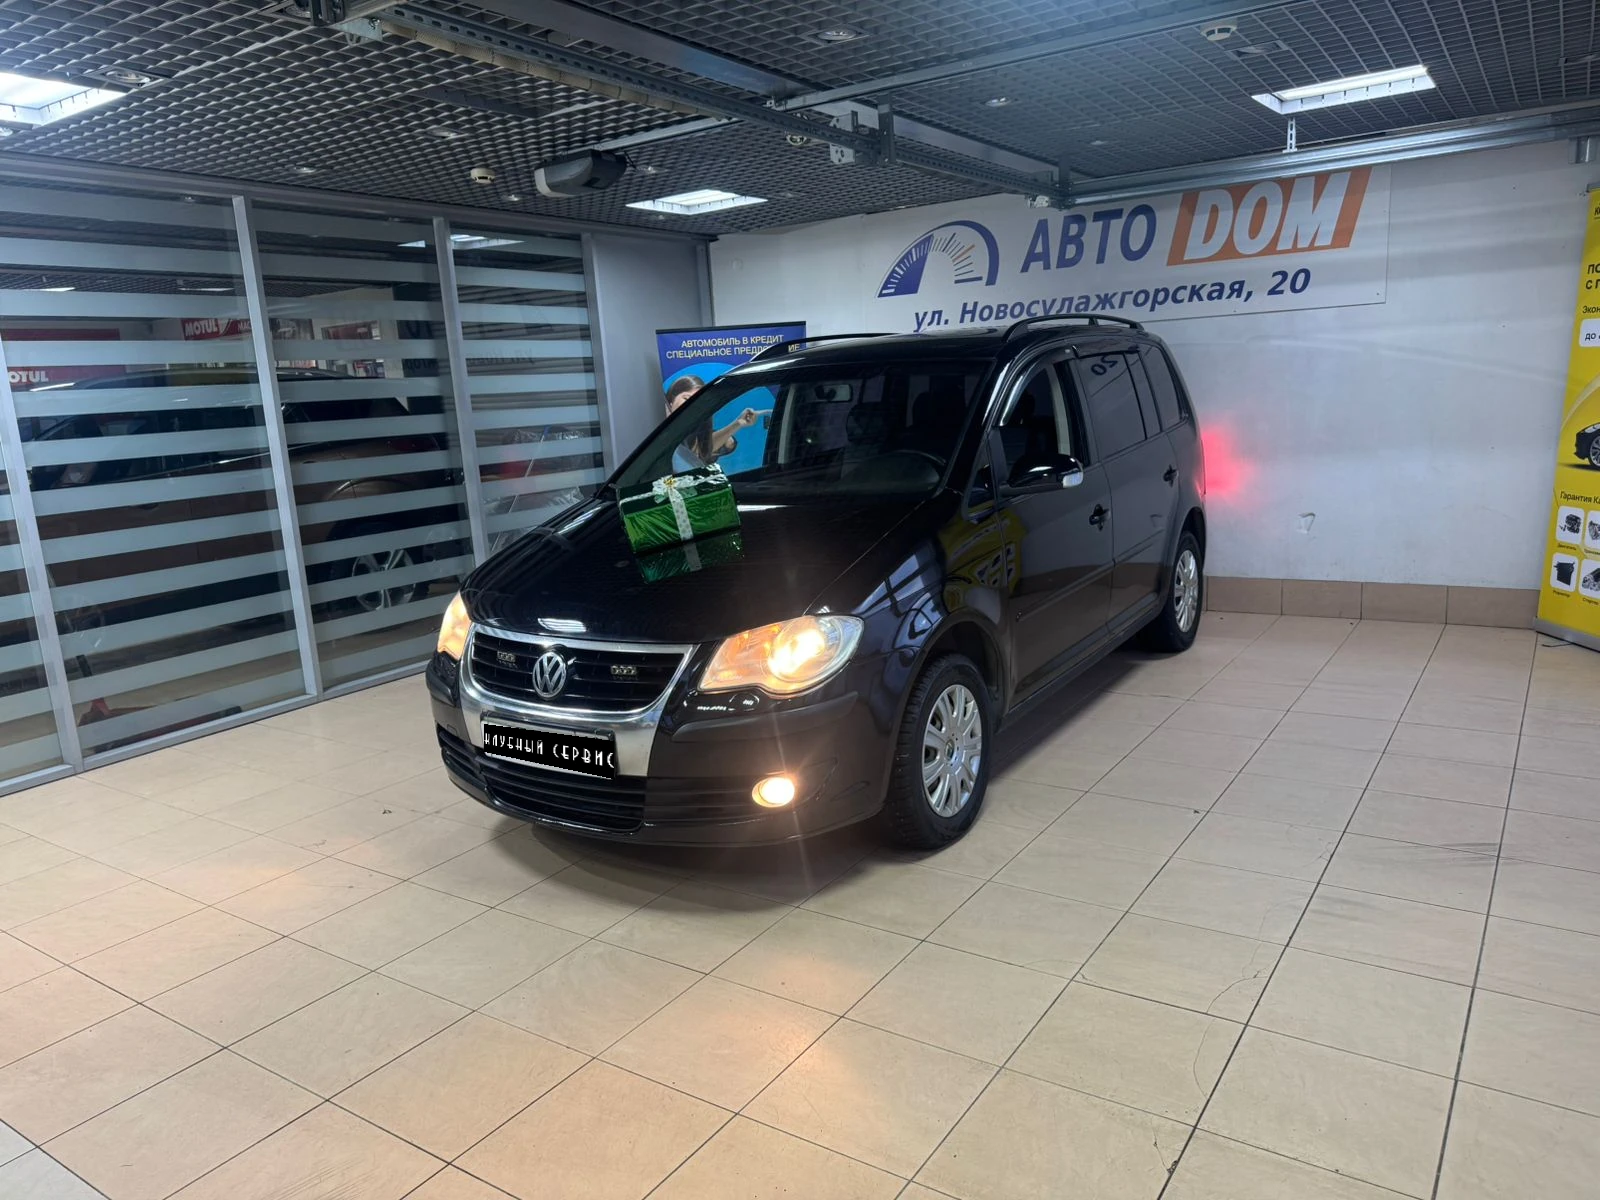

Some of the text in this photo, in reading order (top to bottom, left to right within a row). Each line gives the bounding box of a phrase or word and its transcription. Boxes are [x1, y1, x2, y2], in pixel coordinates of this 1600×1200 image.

[1020, 171, 1352, 273] АВТО DOM
[914, 268, 1311, 333] ул. Новосулажгорская, 20
[184, 318, 219, 337] MOTUL
[681, 334, 785, 348] АВТОМОБИЛЬ В КРЕДИТ
[665, 347, 733, 359] СПЕЦИАЛЬНОЕ
[8, 370, 49, 384] OTUL
